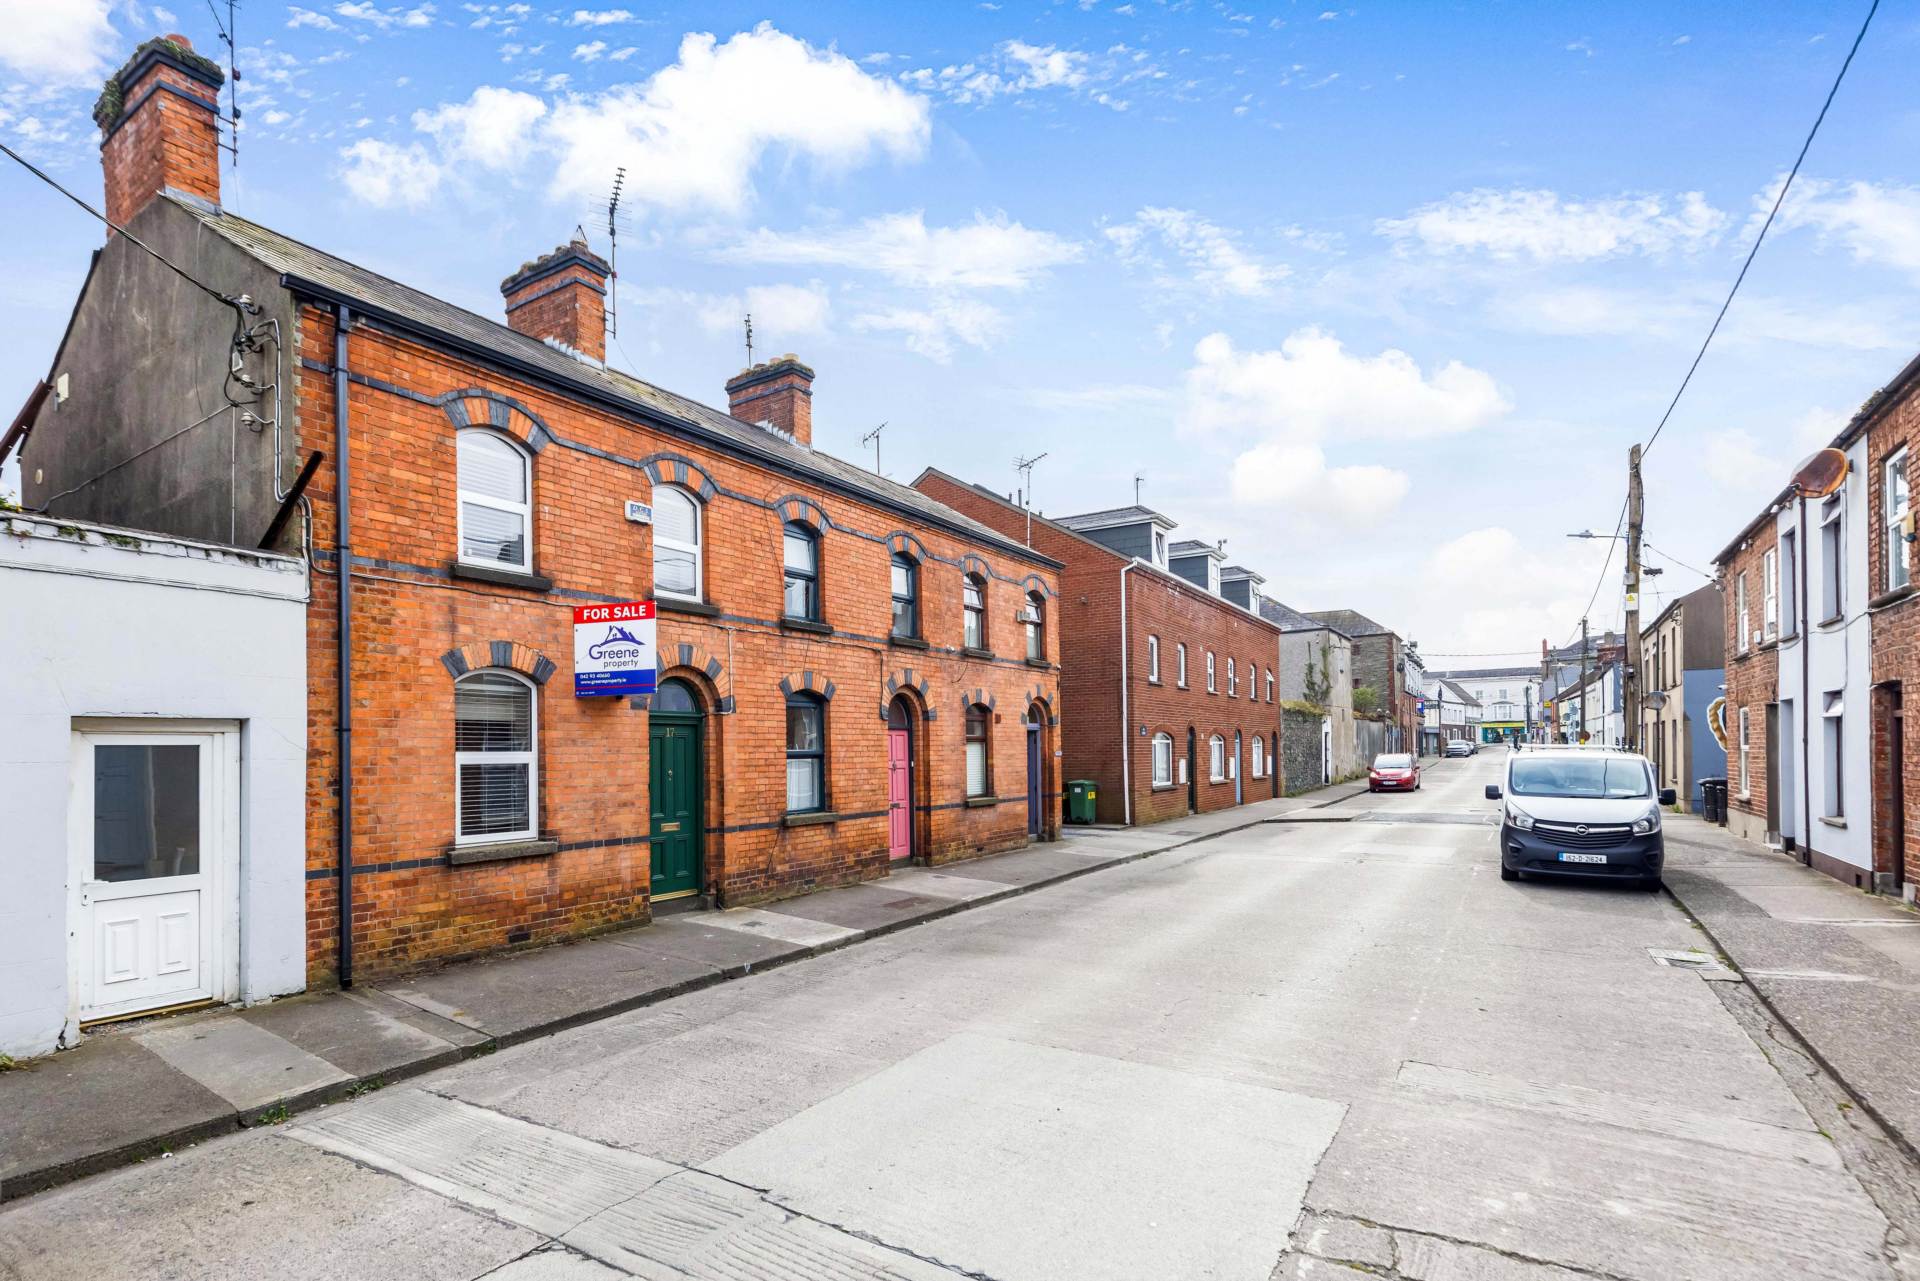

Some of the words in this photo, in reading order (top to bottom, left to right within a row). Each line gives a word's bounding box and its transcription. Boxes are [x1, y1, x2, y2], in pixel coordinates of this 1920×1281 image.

[583, 608, 610, 620] FOR
[613, 605, 646, 618] SALE
[589, 644, 639, 660] Greene
[604, 659, 639, 669] property
[666, 727, 675, 737] 17
